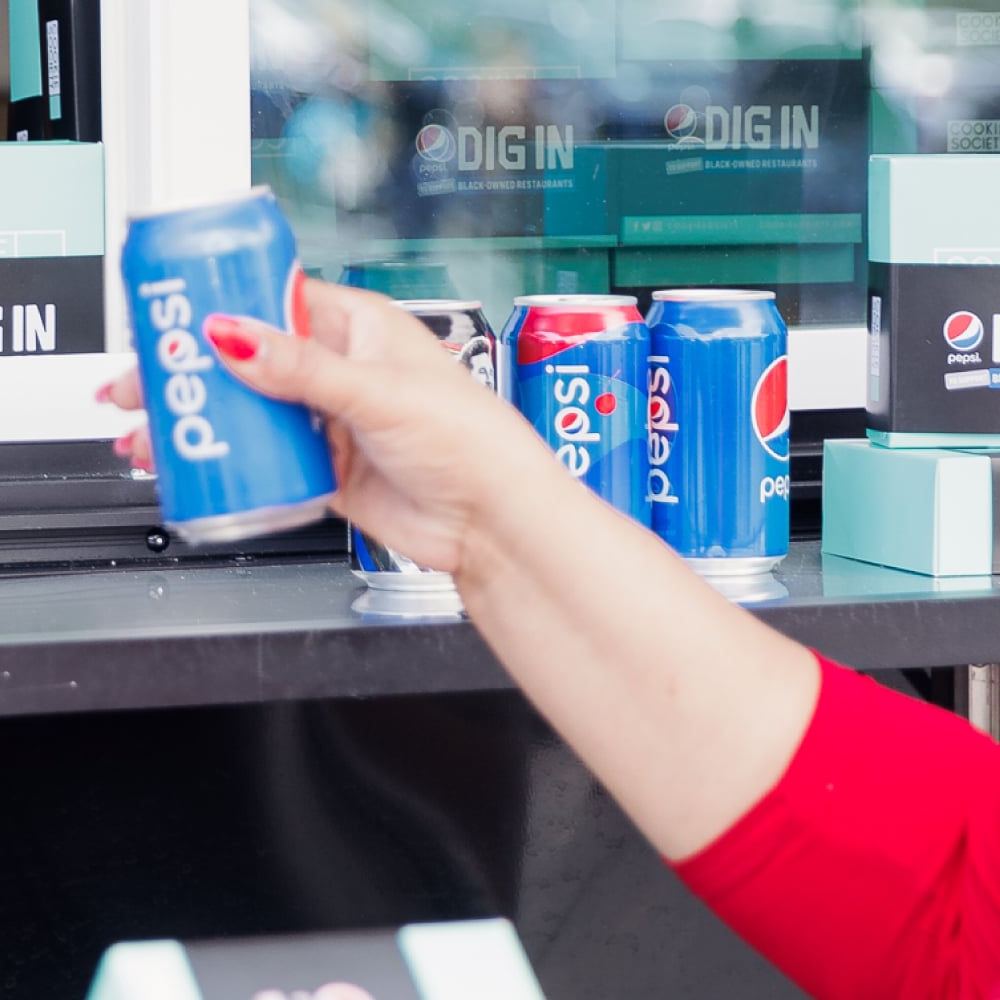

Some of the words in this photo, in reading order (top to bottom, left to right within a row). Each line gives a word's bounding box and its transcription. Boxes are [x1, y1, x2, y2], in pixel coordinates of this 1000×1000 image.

[457, 125, 526, 171] DIG
[534, 124, 575, 170] IN
[704, 104, 772, 151] DIG
[780, 104, 820, 151] IN
[458, 180, 515, 191] BLACK-OWNED
[515, 179, 574, 190] RESTAURANTS
[12, 303, 56, 352] IN
[139, 277, 230, 462] pepsi
[545, 364, 601, 477] epsi
[644, 355, 680, 505] pepsi
